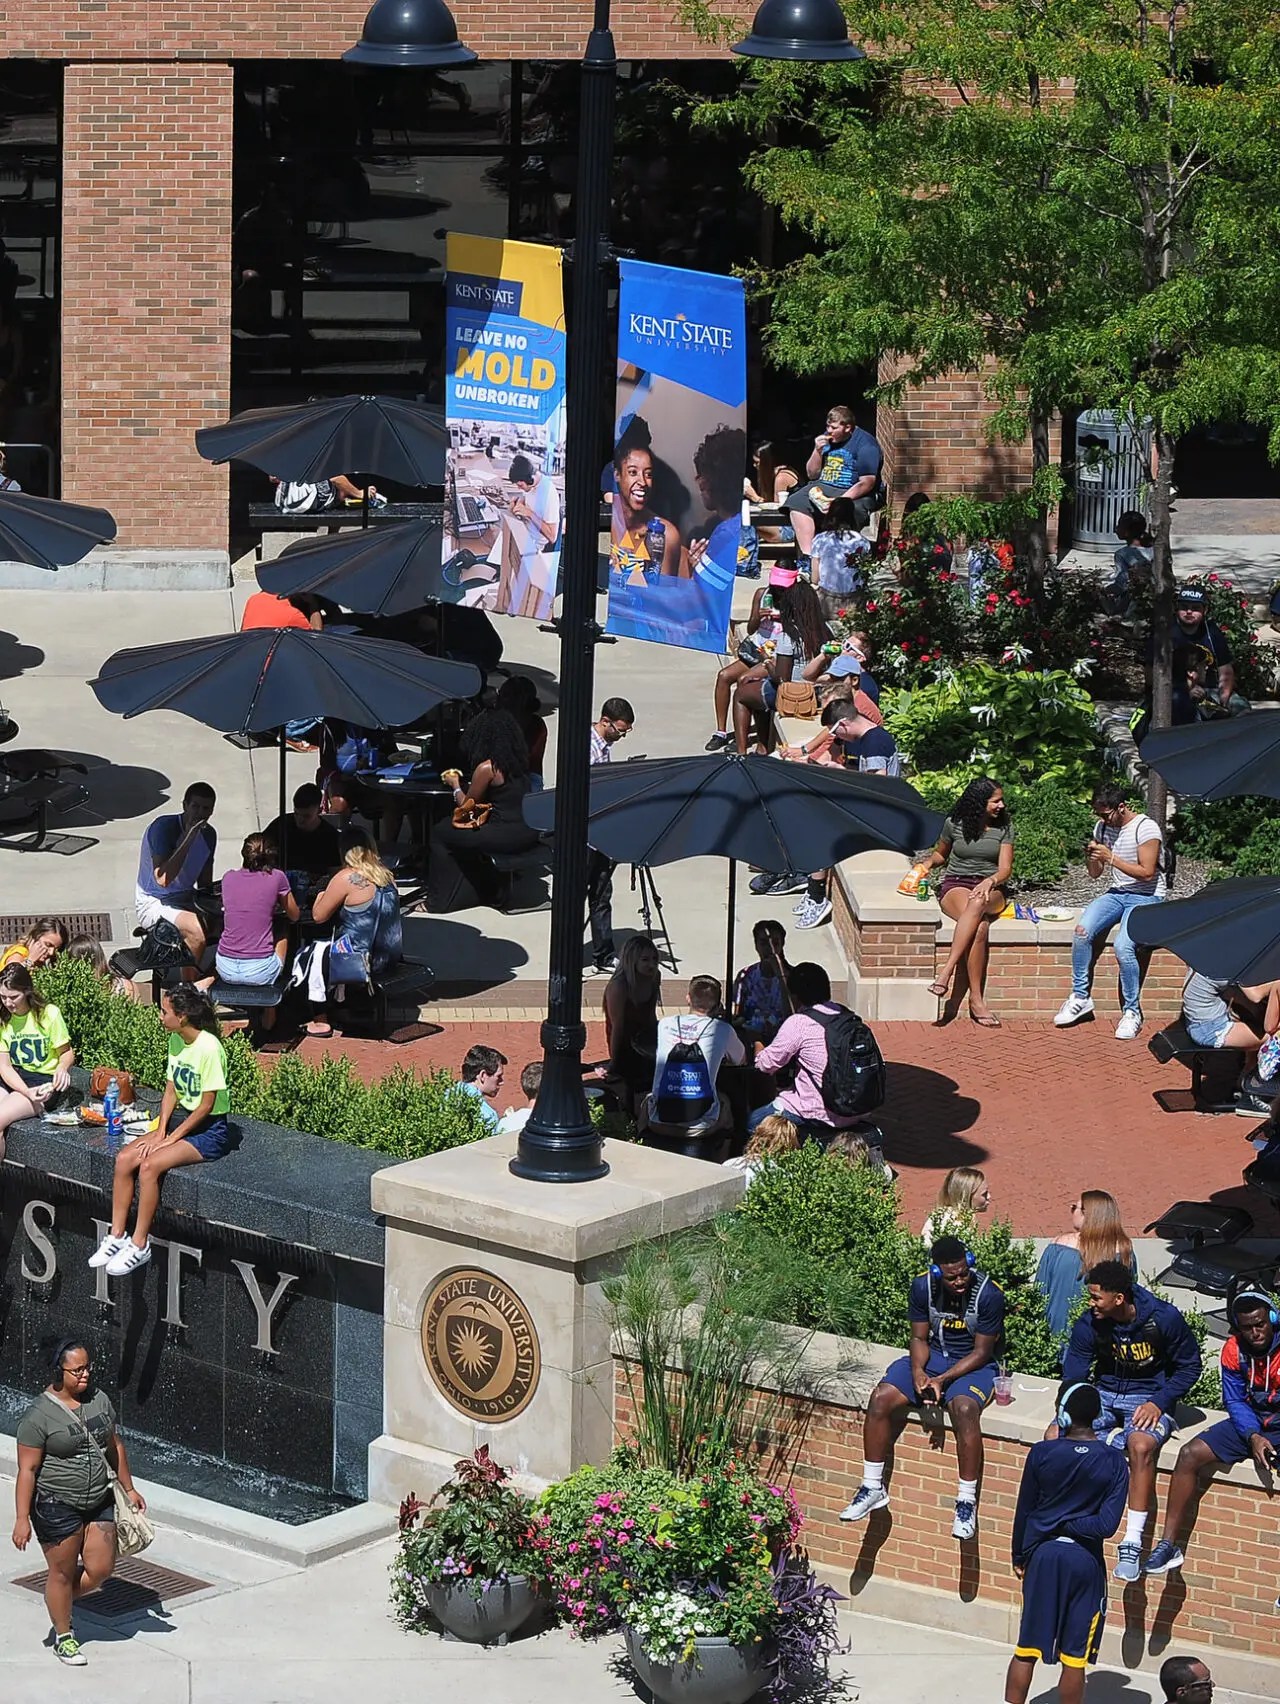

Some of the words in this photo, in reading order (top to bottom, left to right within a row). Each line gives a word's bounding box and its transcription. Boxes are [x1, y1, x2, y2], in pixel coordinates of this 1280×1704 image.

[455, 283, 484, 299] KENT
[485, 287, 515, 304] STATE
[455, 327, 503, 347] LEAVE
[504, 333, 528, 350] NO
[629, 313, 680, 339] KENT
[682, 322, 733, 349] STATE
[636, 335, 727, 356] UNIVERSITY
[454, 346, 557, 391] MOLD
[455, 384, 540, 410] UNBROKEN
[439, 1279, 478, 1307] STATE
[487, 1285, 533, 1390] UNIVERSITY
[438, 1372, 471, 1408] OHIO
[483, 1394, 515, 1414] 1910
